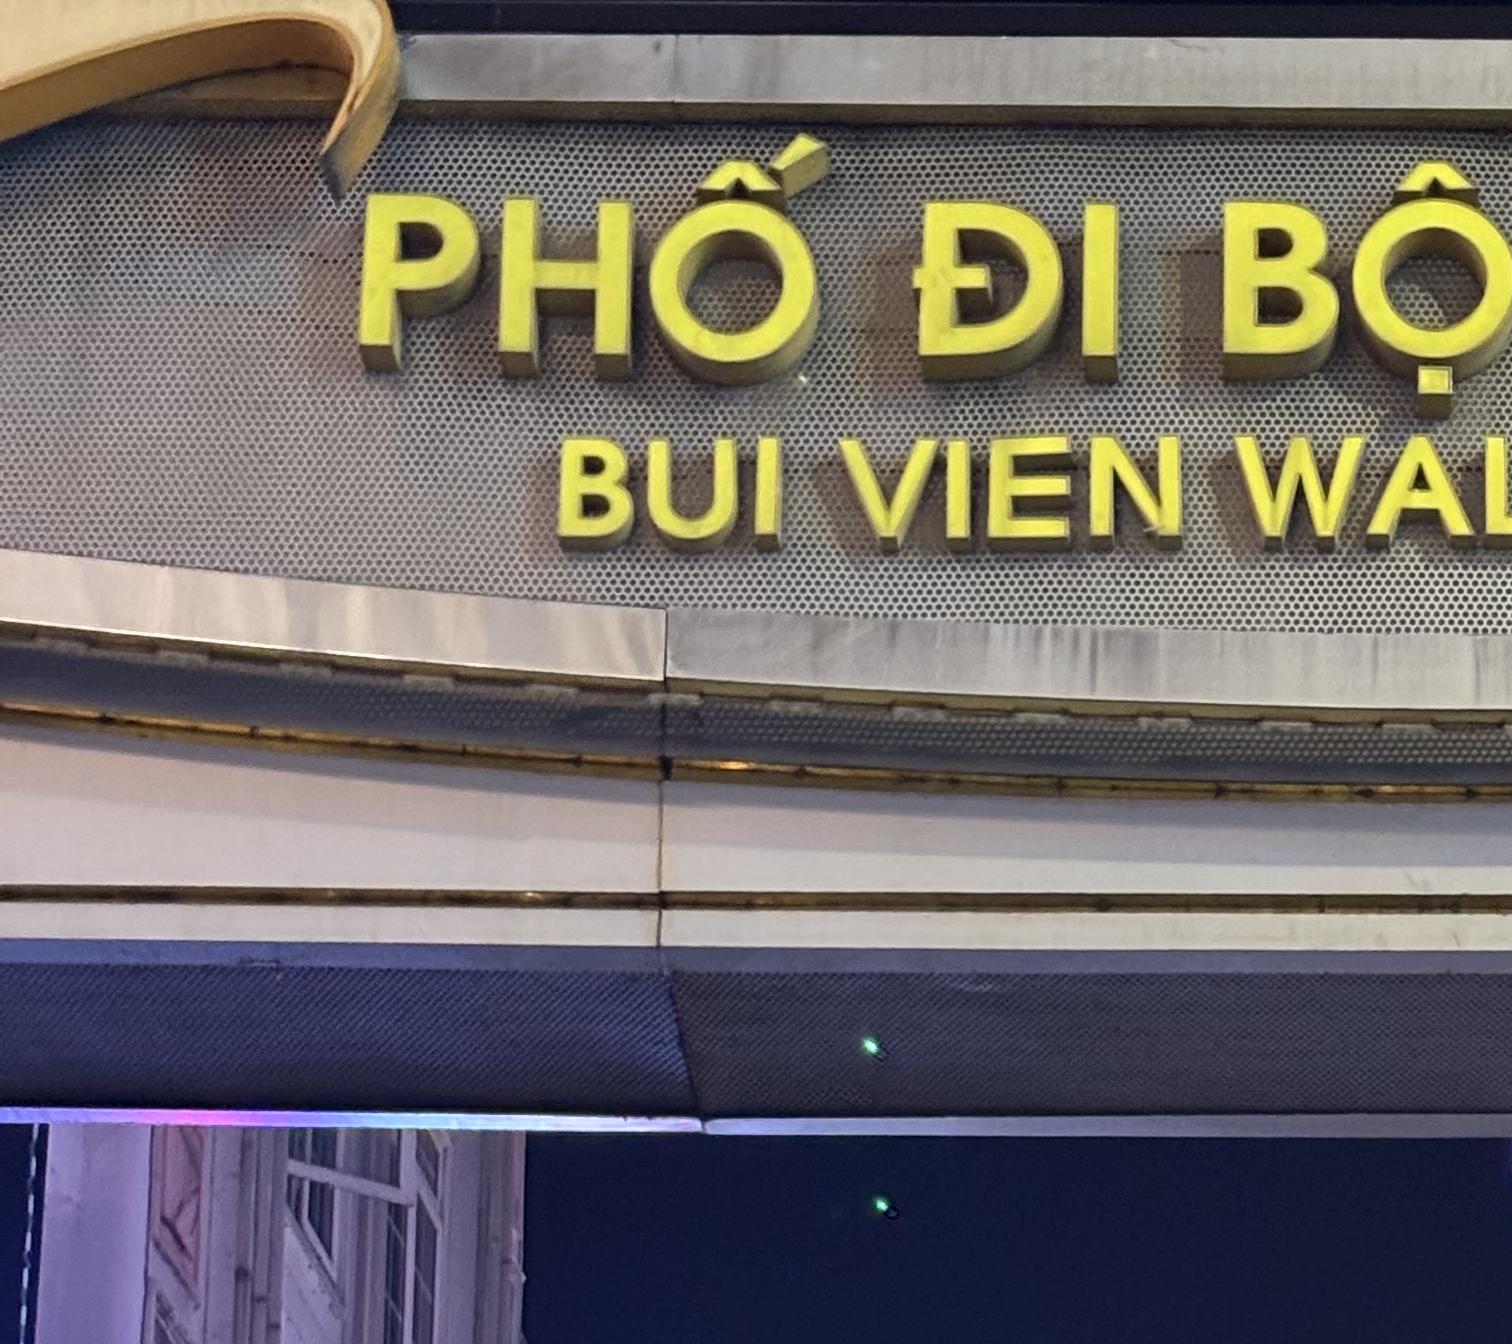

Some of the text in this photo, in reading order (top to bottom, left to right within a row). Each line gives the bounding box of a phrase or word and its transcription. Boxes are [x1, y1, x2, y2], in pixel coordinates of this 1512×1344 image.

[360, 134, 830, 375] PHỐ
[913, 200, 1119, 377] ĐI
[557, 436, 785, 550] BUI
[840, 435, 1184, 550] VIEN
